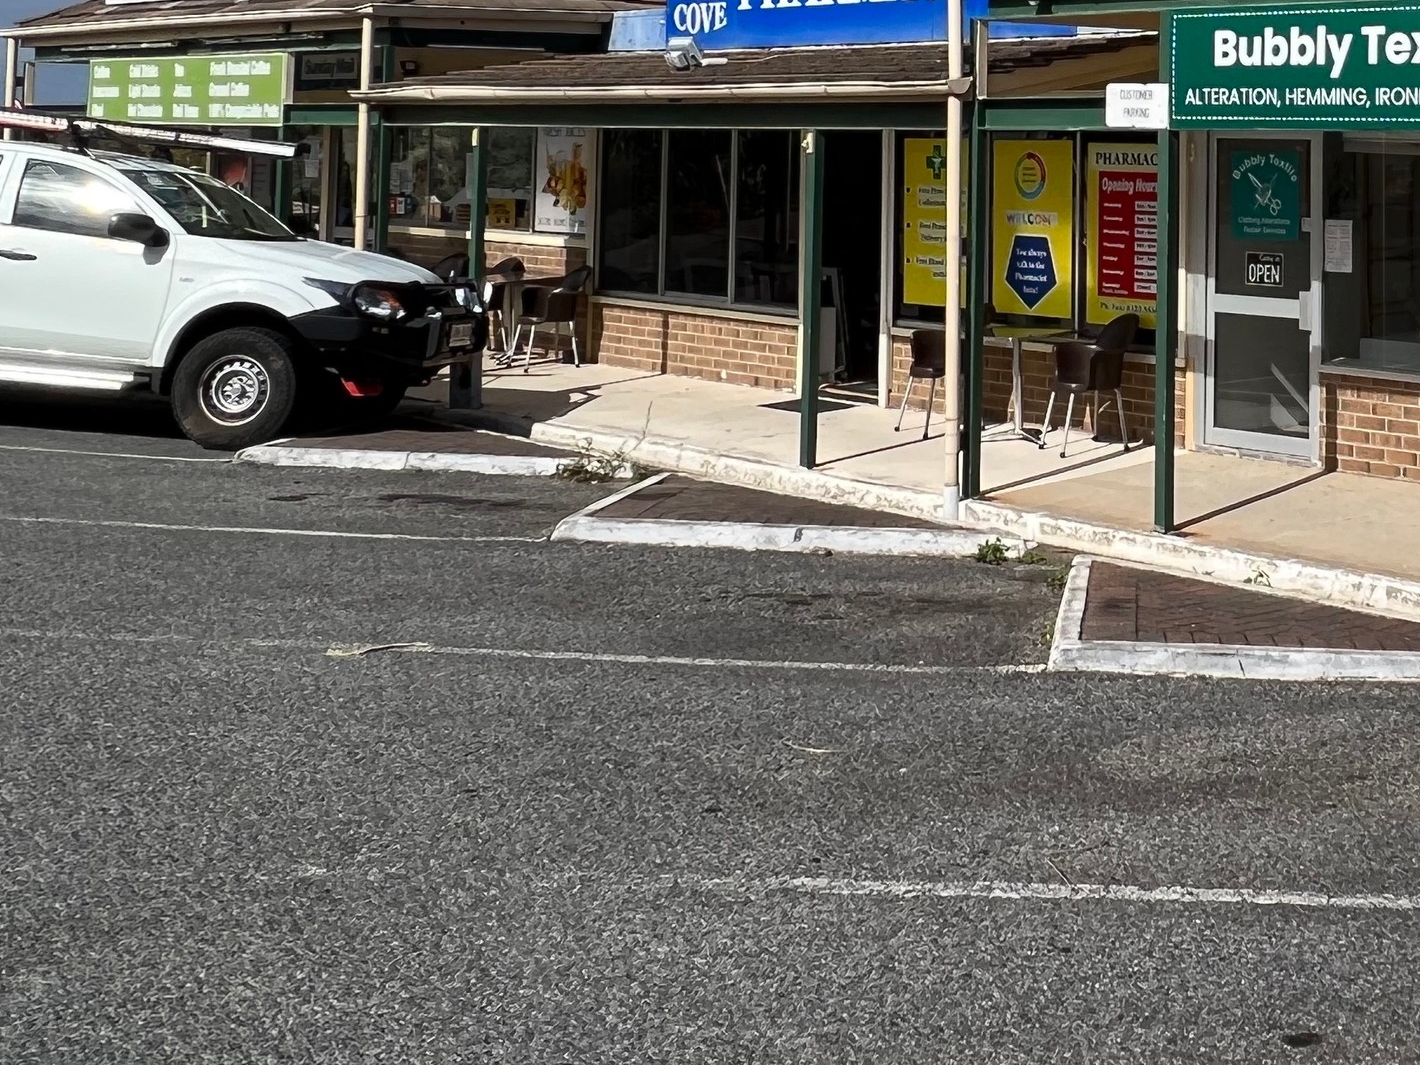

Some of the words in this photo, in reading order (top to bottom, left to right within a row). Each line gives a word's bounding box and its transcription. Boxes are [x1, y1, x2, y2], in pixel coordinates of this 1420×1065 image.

[673, 1, 728, 35] COVE
[1213, 24, 1353, 79] Bubbly
[1119, 89, 1153, 100] CUSTOMER
[1184, 87, 1282, 108] ALTERATION,
[1285, 86, 1371, 109] HEMMING,
[1123, 107, 1150, 118] PARKING
[1095, 151, 1158, 166] PHARMAC
[1101, 176, 1134, 195] Opening
[1135, 178, 1158, 193] Hour
[1248, 263, 1281, 283] OPEN
